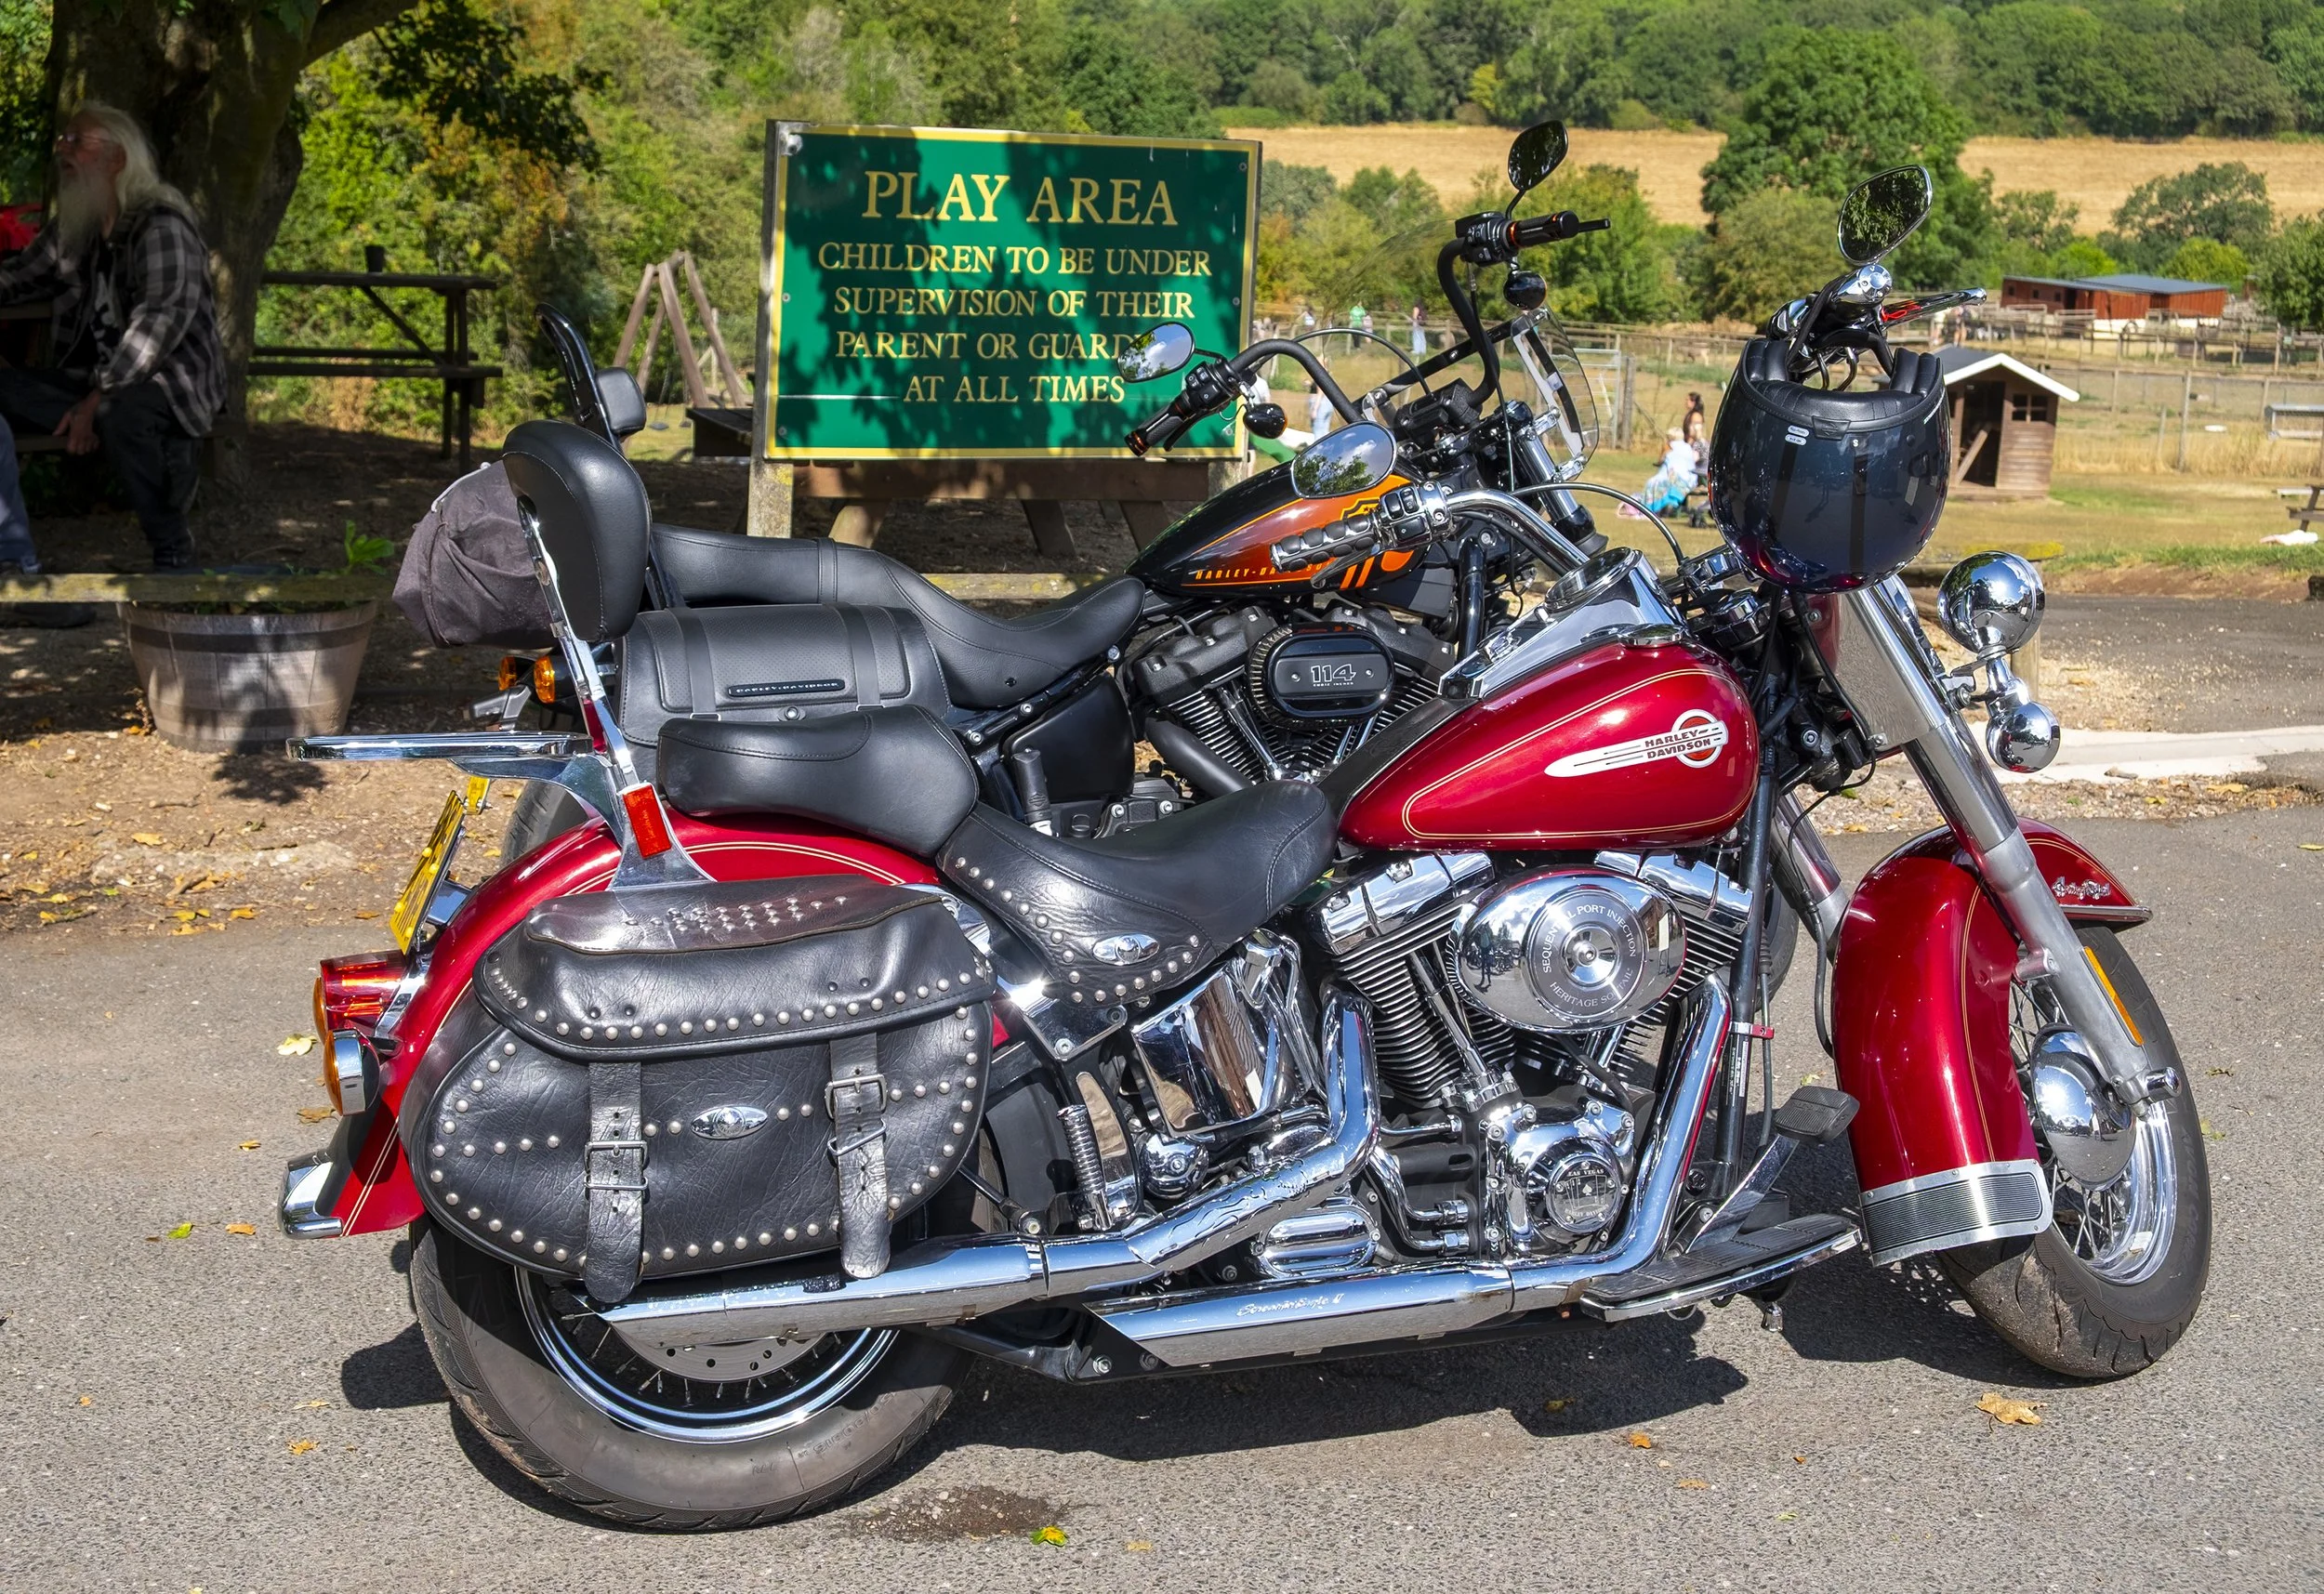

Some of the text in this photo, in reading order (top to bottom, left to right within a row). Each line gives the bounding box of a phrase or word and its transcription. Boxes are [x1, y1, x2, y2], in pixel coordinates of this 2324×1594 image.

[862, 170, 1178, 226] PLAY AREA
[818, 242, 1212, 277] CHILDREN TO BE UNDER
[834, 287, 1195, 318] SUPERVISION OF THEIR
[836, 332, 1142, 360] PARENT OR GUARD
[903, 376, 1125, 403] AT ALL TIMES
[1852, 439, 1859, 447] S
[1195, 563, 1330, 580] HARLEY-DASO
[1311, 664, 1356, 683] 114
[1647, 738, 1710, 759] DAVIDSON
[1541, 904, 1636, 973] SEQUENTL PORT INJECTION
[1550, 969, 1633, 1008] HERITAGE SOTAIL
